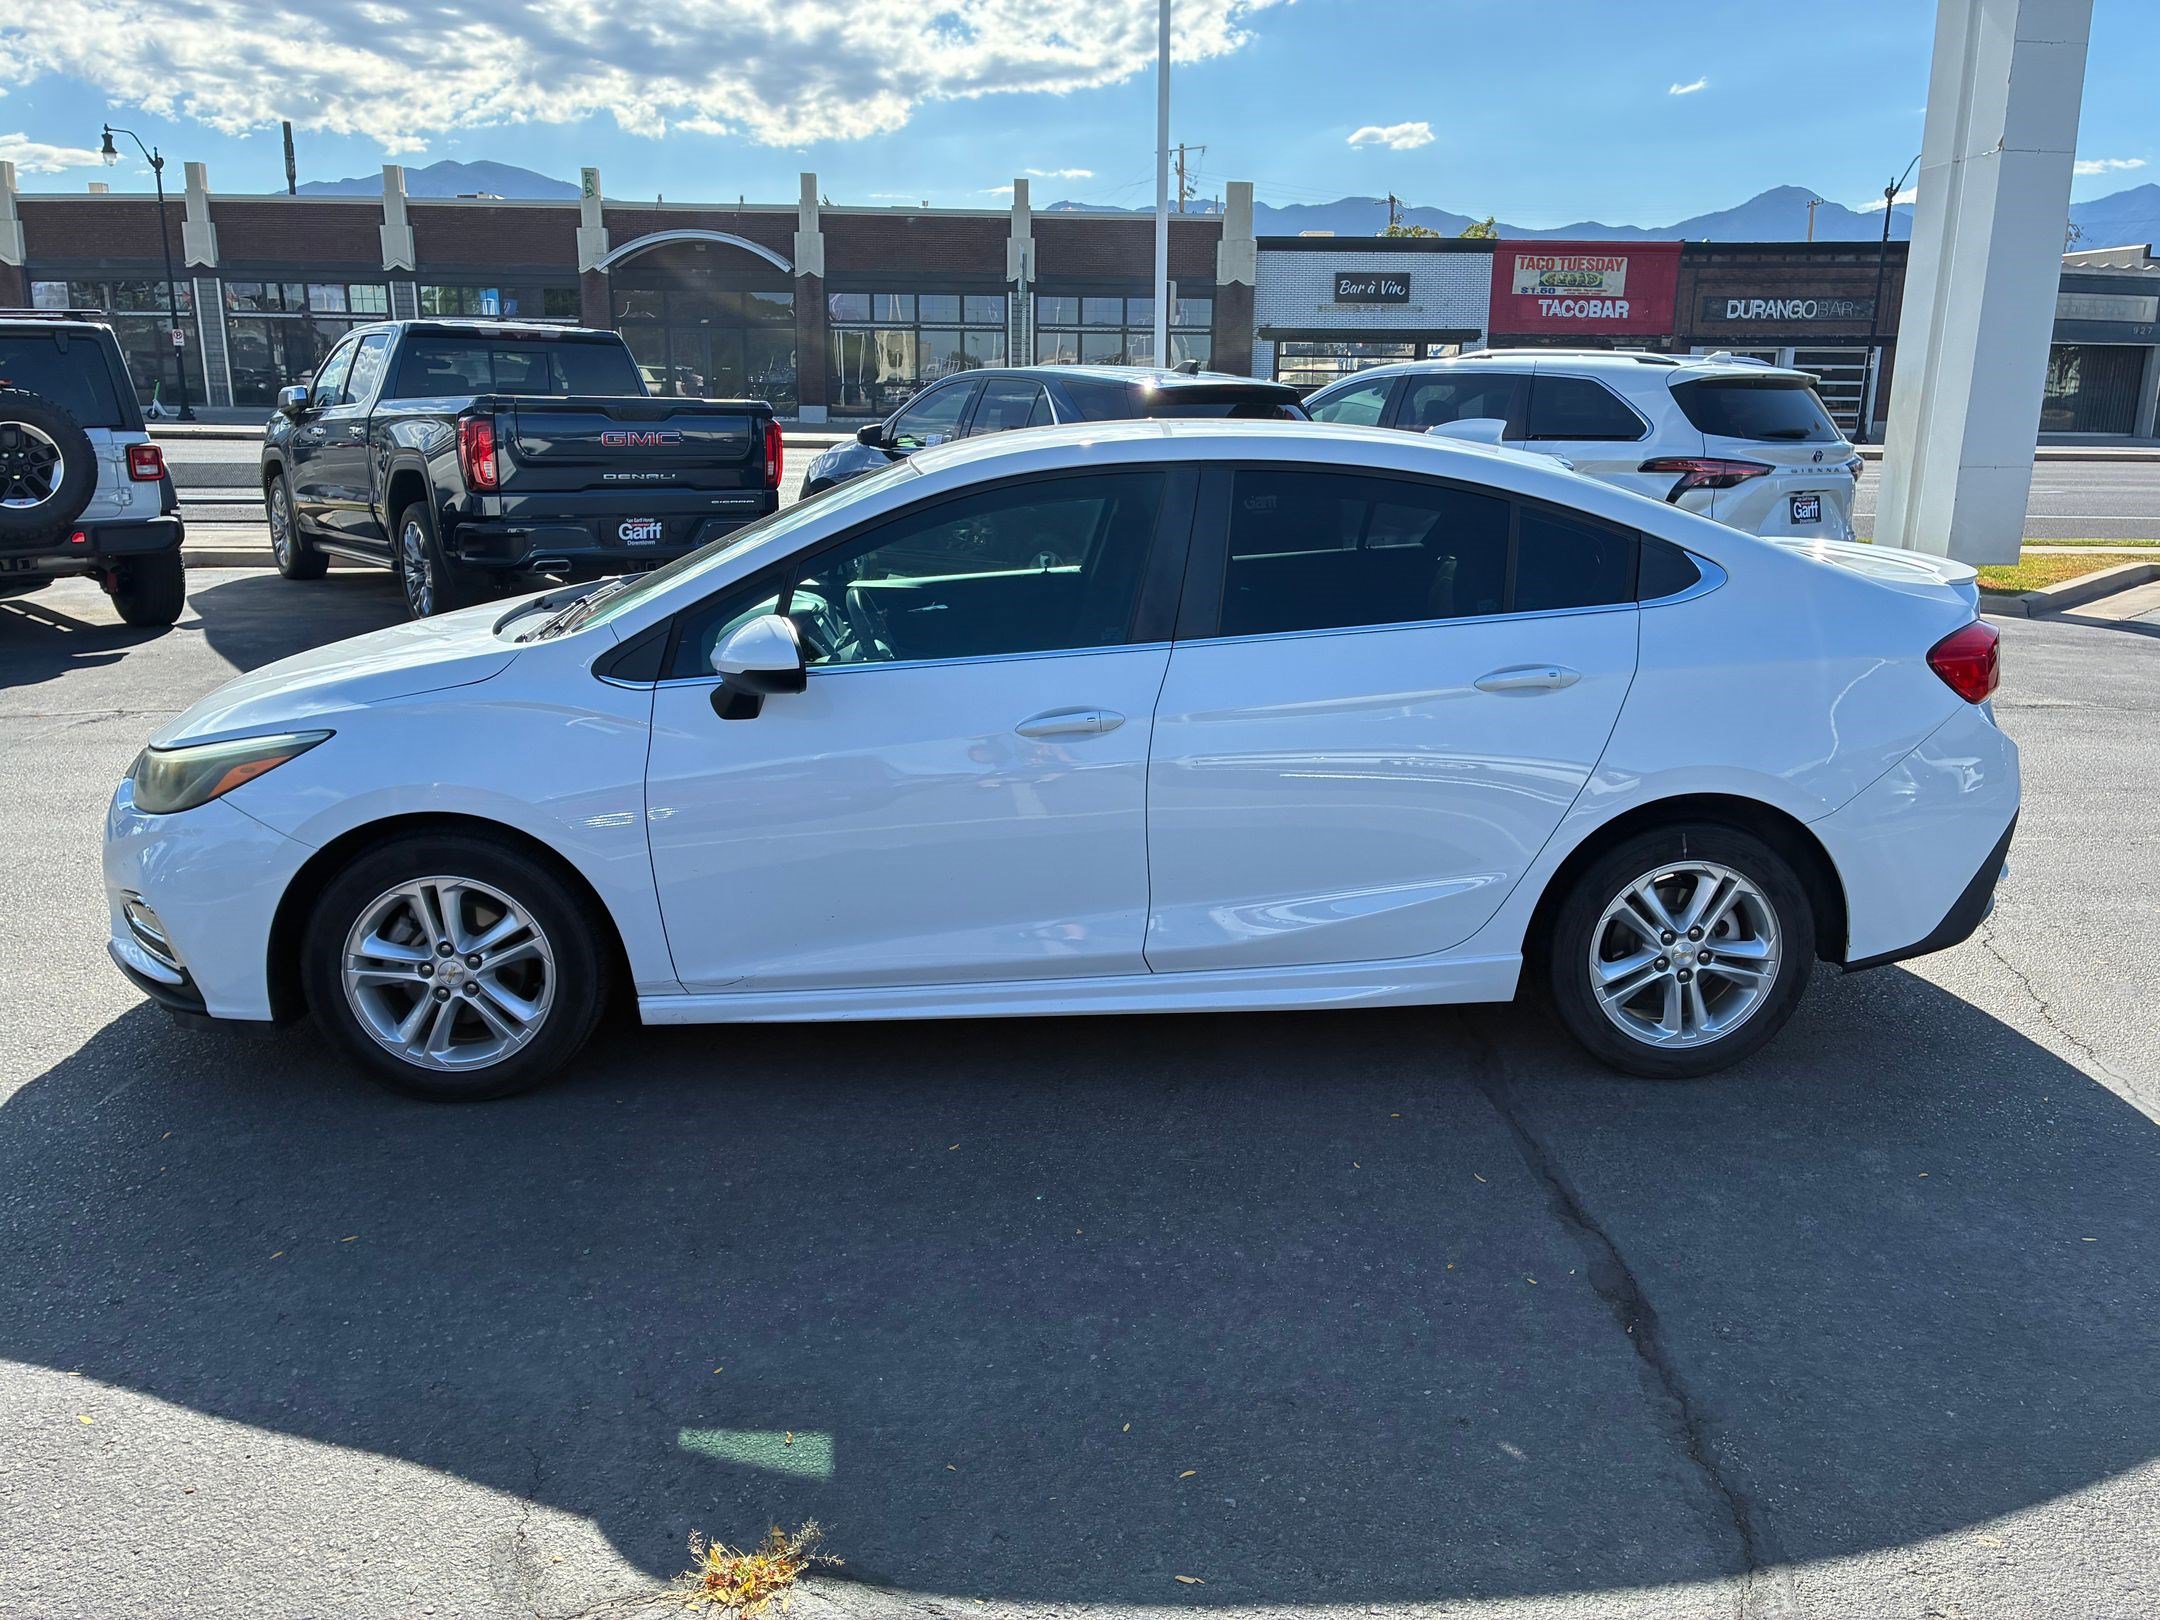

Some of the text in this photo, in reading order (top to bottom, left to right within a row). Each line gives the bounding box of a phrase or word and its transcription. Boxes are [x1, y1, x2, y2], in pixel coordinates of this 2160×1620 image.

[1519, 257, 1624, 272] TACO TUESDAY
[1339, 280, 1406, 296] Bar à Vin
[1520, 286, 1556, 295] $1.50
[1538, 299, 1630, 319] TACOBAR
[601, 431, 681, 447] GMC
[1793, 501, 1818, 518] Garff
[618, 522, 662, 540] Garff
